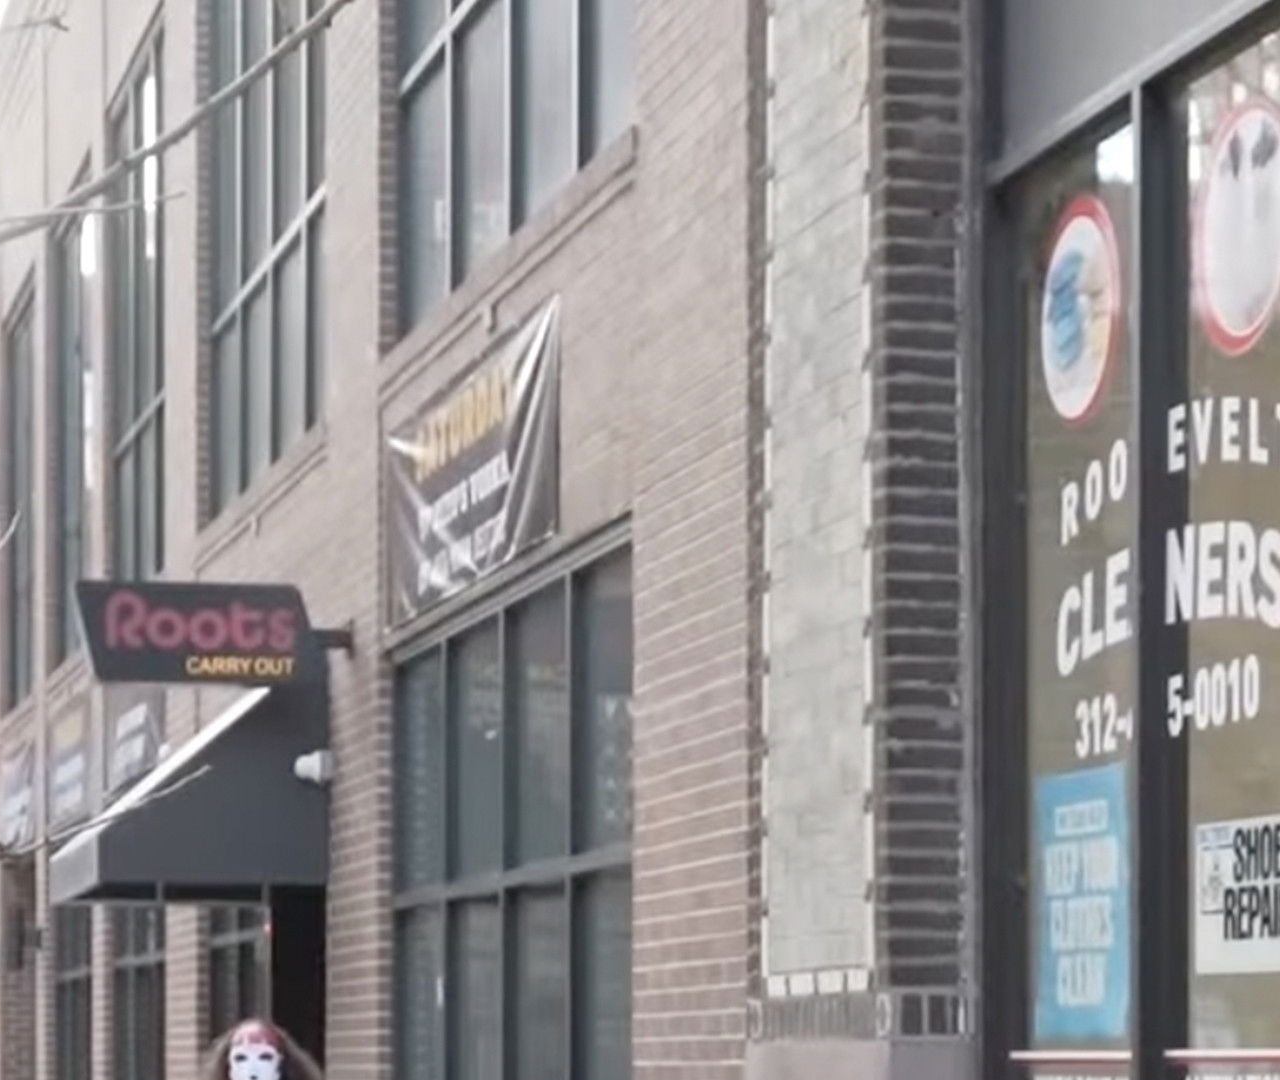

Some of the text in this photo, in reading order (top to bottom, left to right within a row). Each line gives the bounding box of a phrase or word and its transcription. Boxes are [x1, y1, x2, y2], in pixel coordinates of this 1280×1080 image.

[104, 588, 296, 650] Roots
[185, 656, 295, 676] CARRY OUT
